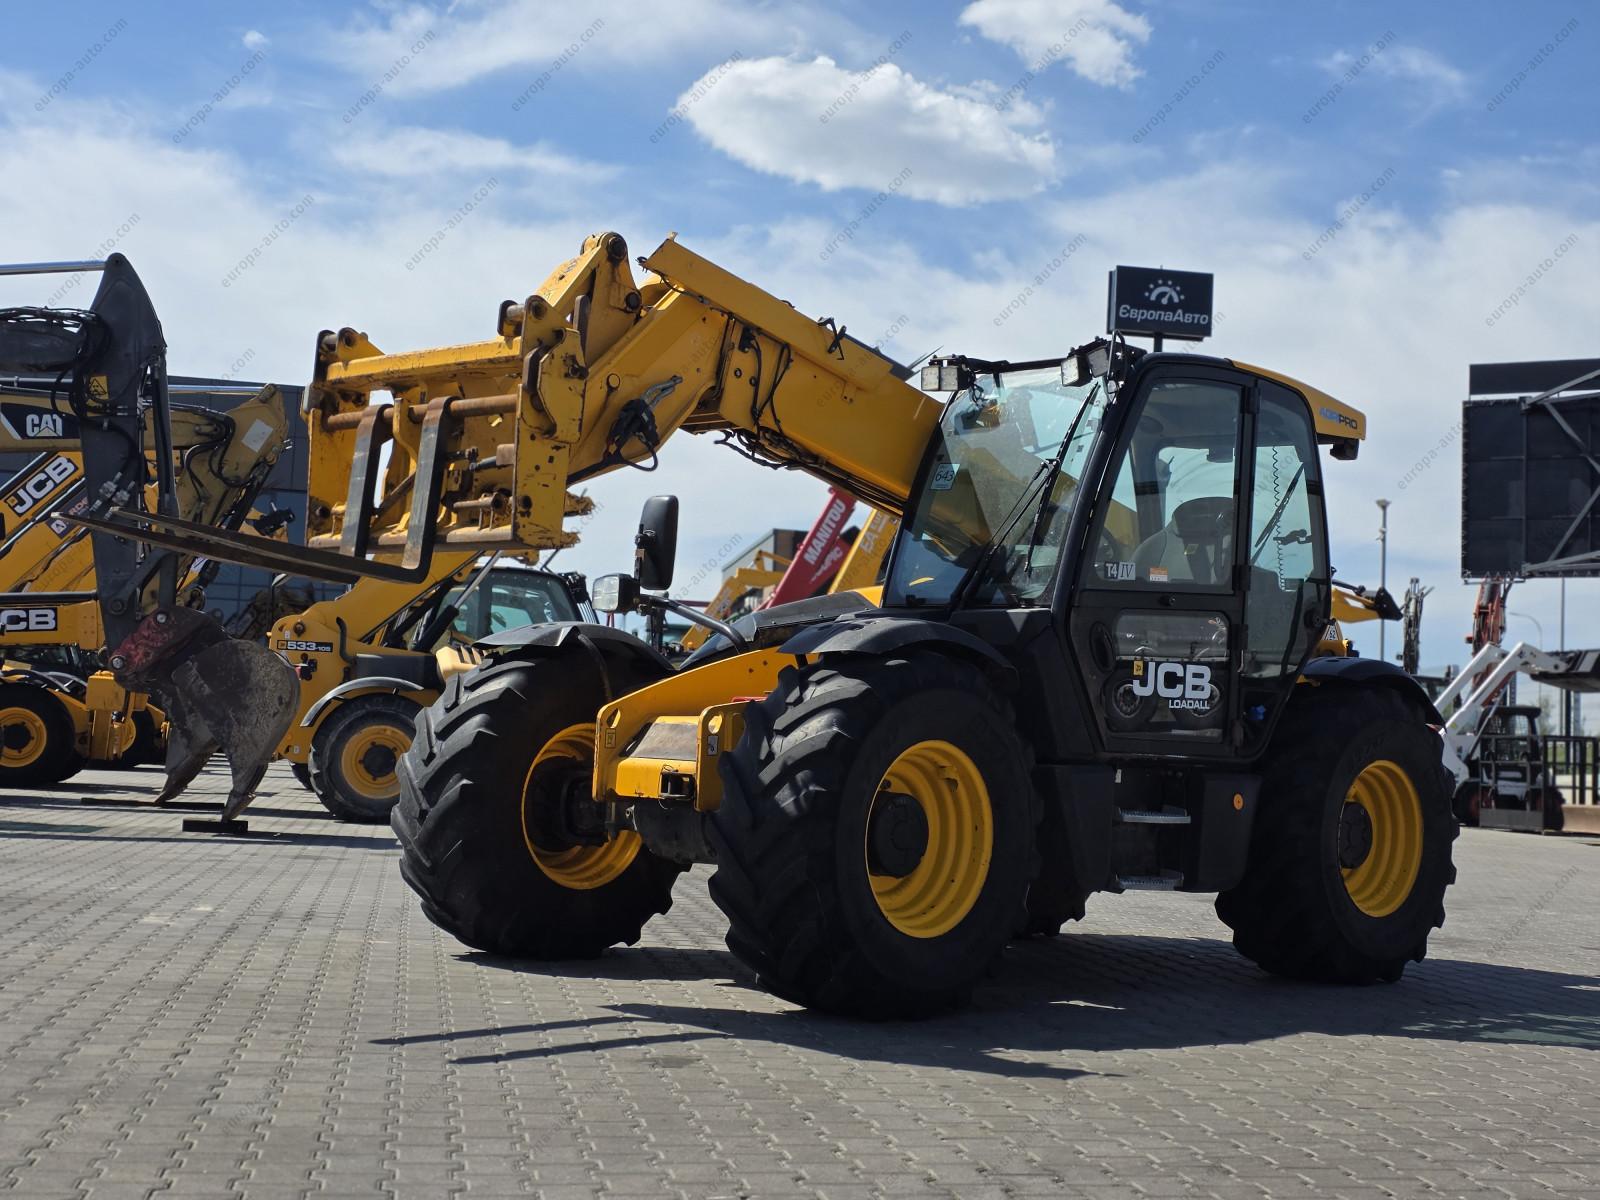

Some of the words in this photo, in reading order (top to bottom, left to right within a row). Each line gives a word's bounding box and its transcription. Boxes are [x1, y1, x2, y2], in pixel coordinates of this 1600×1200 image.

[1118, 304, 1210, 325] ЄвропаАвто
[25, 413, 64, 437] CAT
[13, 456, 77, 515] JCB
[803, 498, 846, 566] MANITOU
[1105, 563, 1118, 578] T4
[0, 609, 56, 631] CB
[1132, 661, 1211, 700] JCB
[1168, 699, 1211, 710] LOADALL
